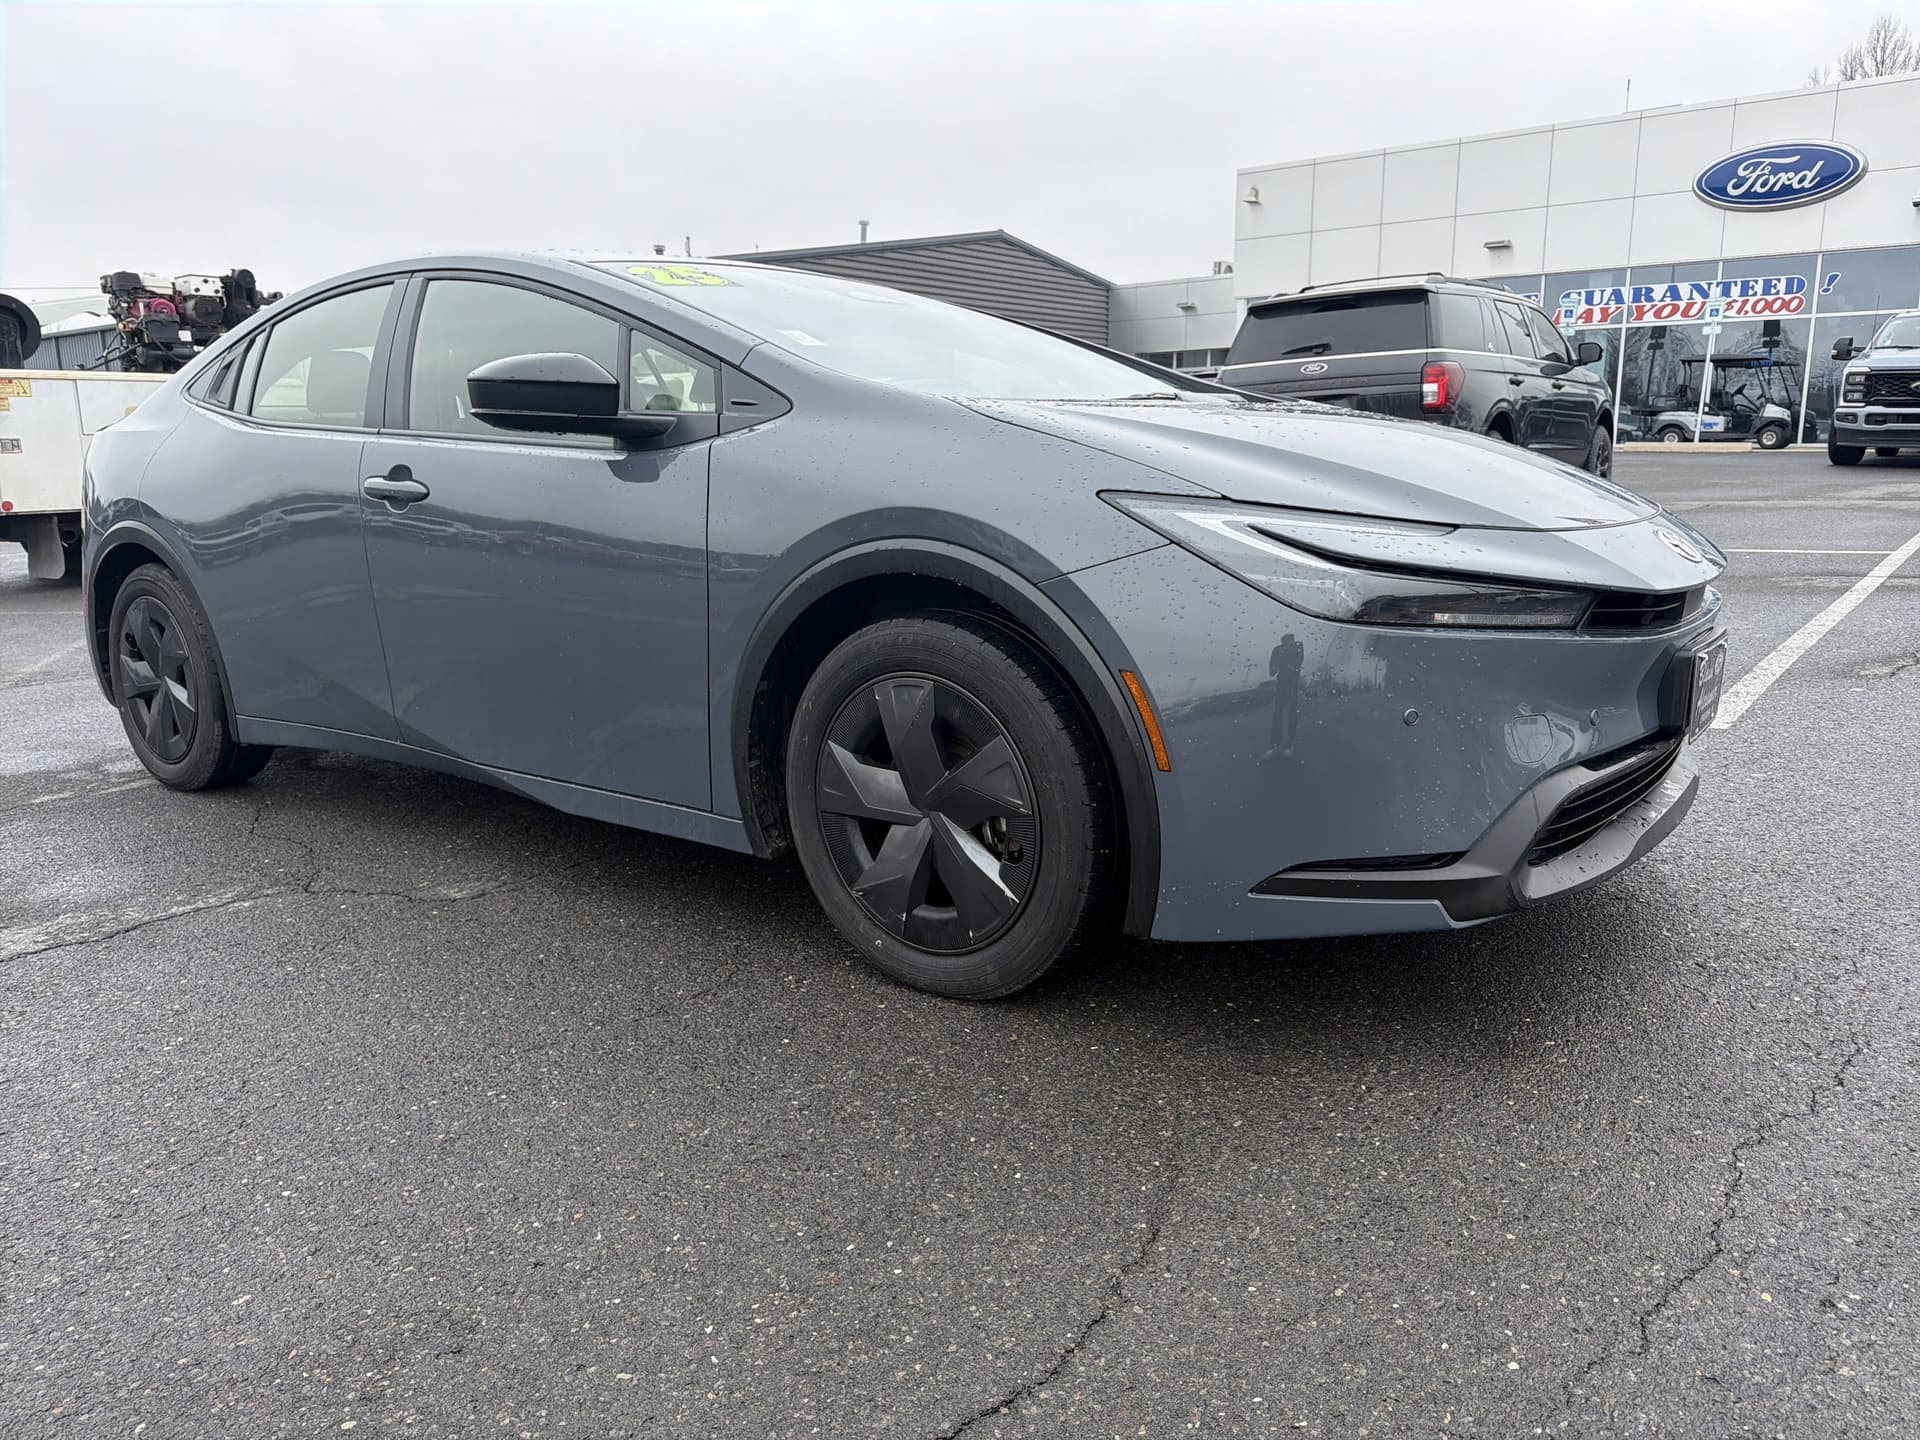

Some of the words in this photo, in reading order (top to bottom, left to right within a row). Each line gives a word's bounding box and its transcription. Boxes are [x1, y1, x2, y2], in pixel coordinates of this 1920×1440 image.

[1727, 155, 1825, 196] Ford
[1632, 301, 1707, 322] YOU
[1723, 295, 1805, 316] $1,000
